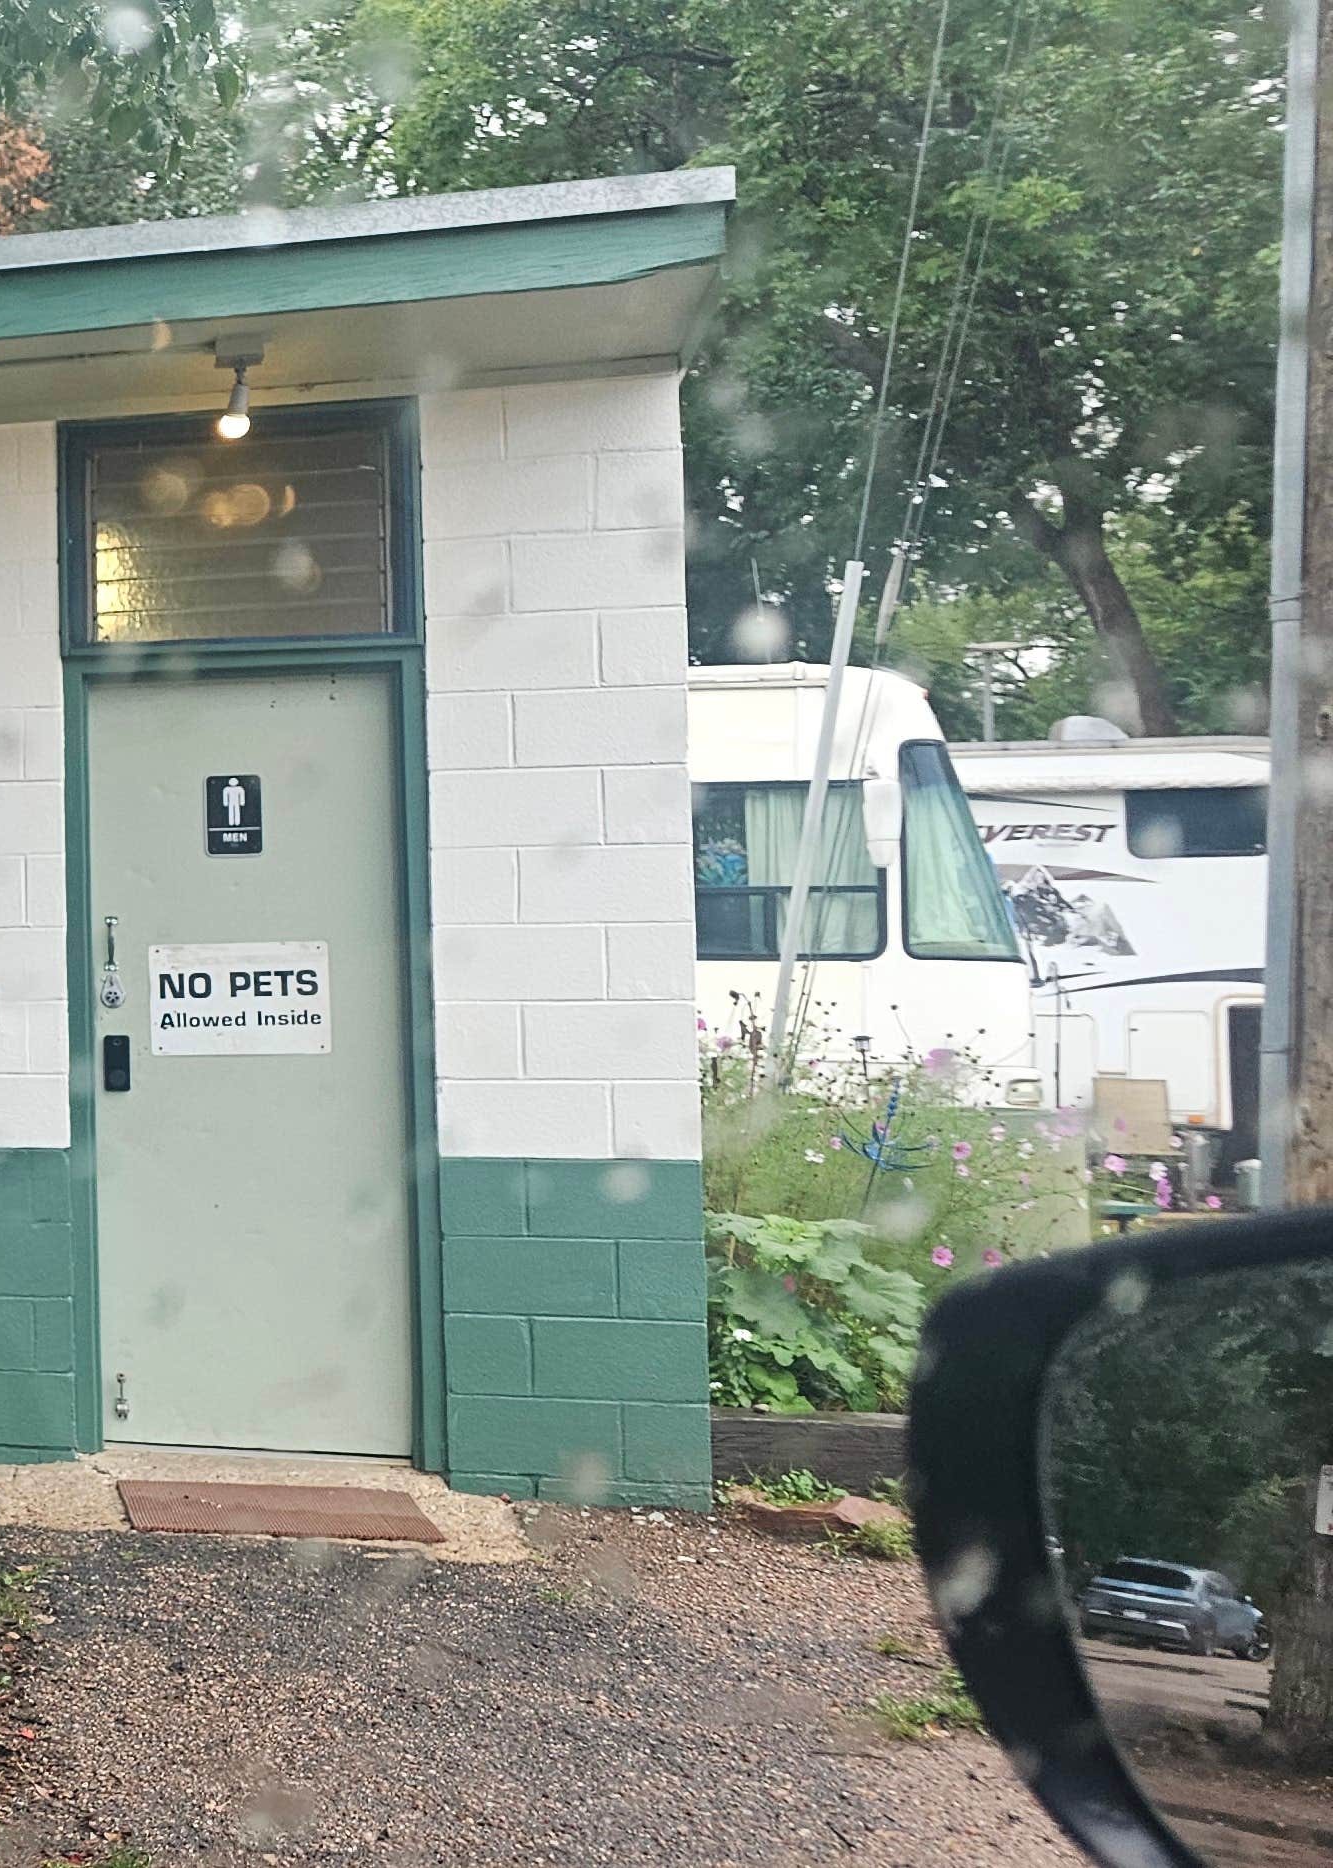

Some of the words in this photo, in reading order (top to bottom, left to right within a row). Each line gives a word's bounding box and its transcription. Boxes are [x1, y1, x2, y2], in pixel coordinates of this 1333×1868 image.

[223, 832, 247, 842] MEN
[976, 824, 1117, 843] VEREST
[159, 972, 212, 999] NO
[229, 969, 319, 997] PETS
[160, 1011, 246, 1029] Allowed
[257, 1009, 322, 1026] Inside
